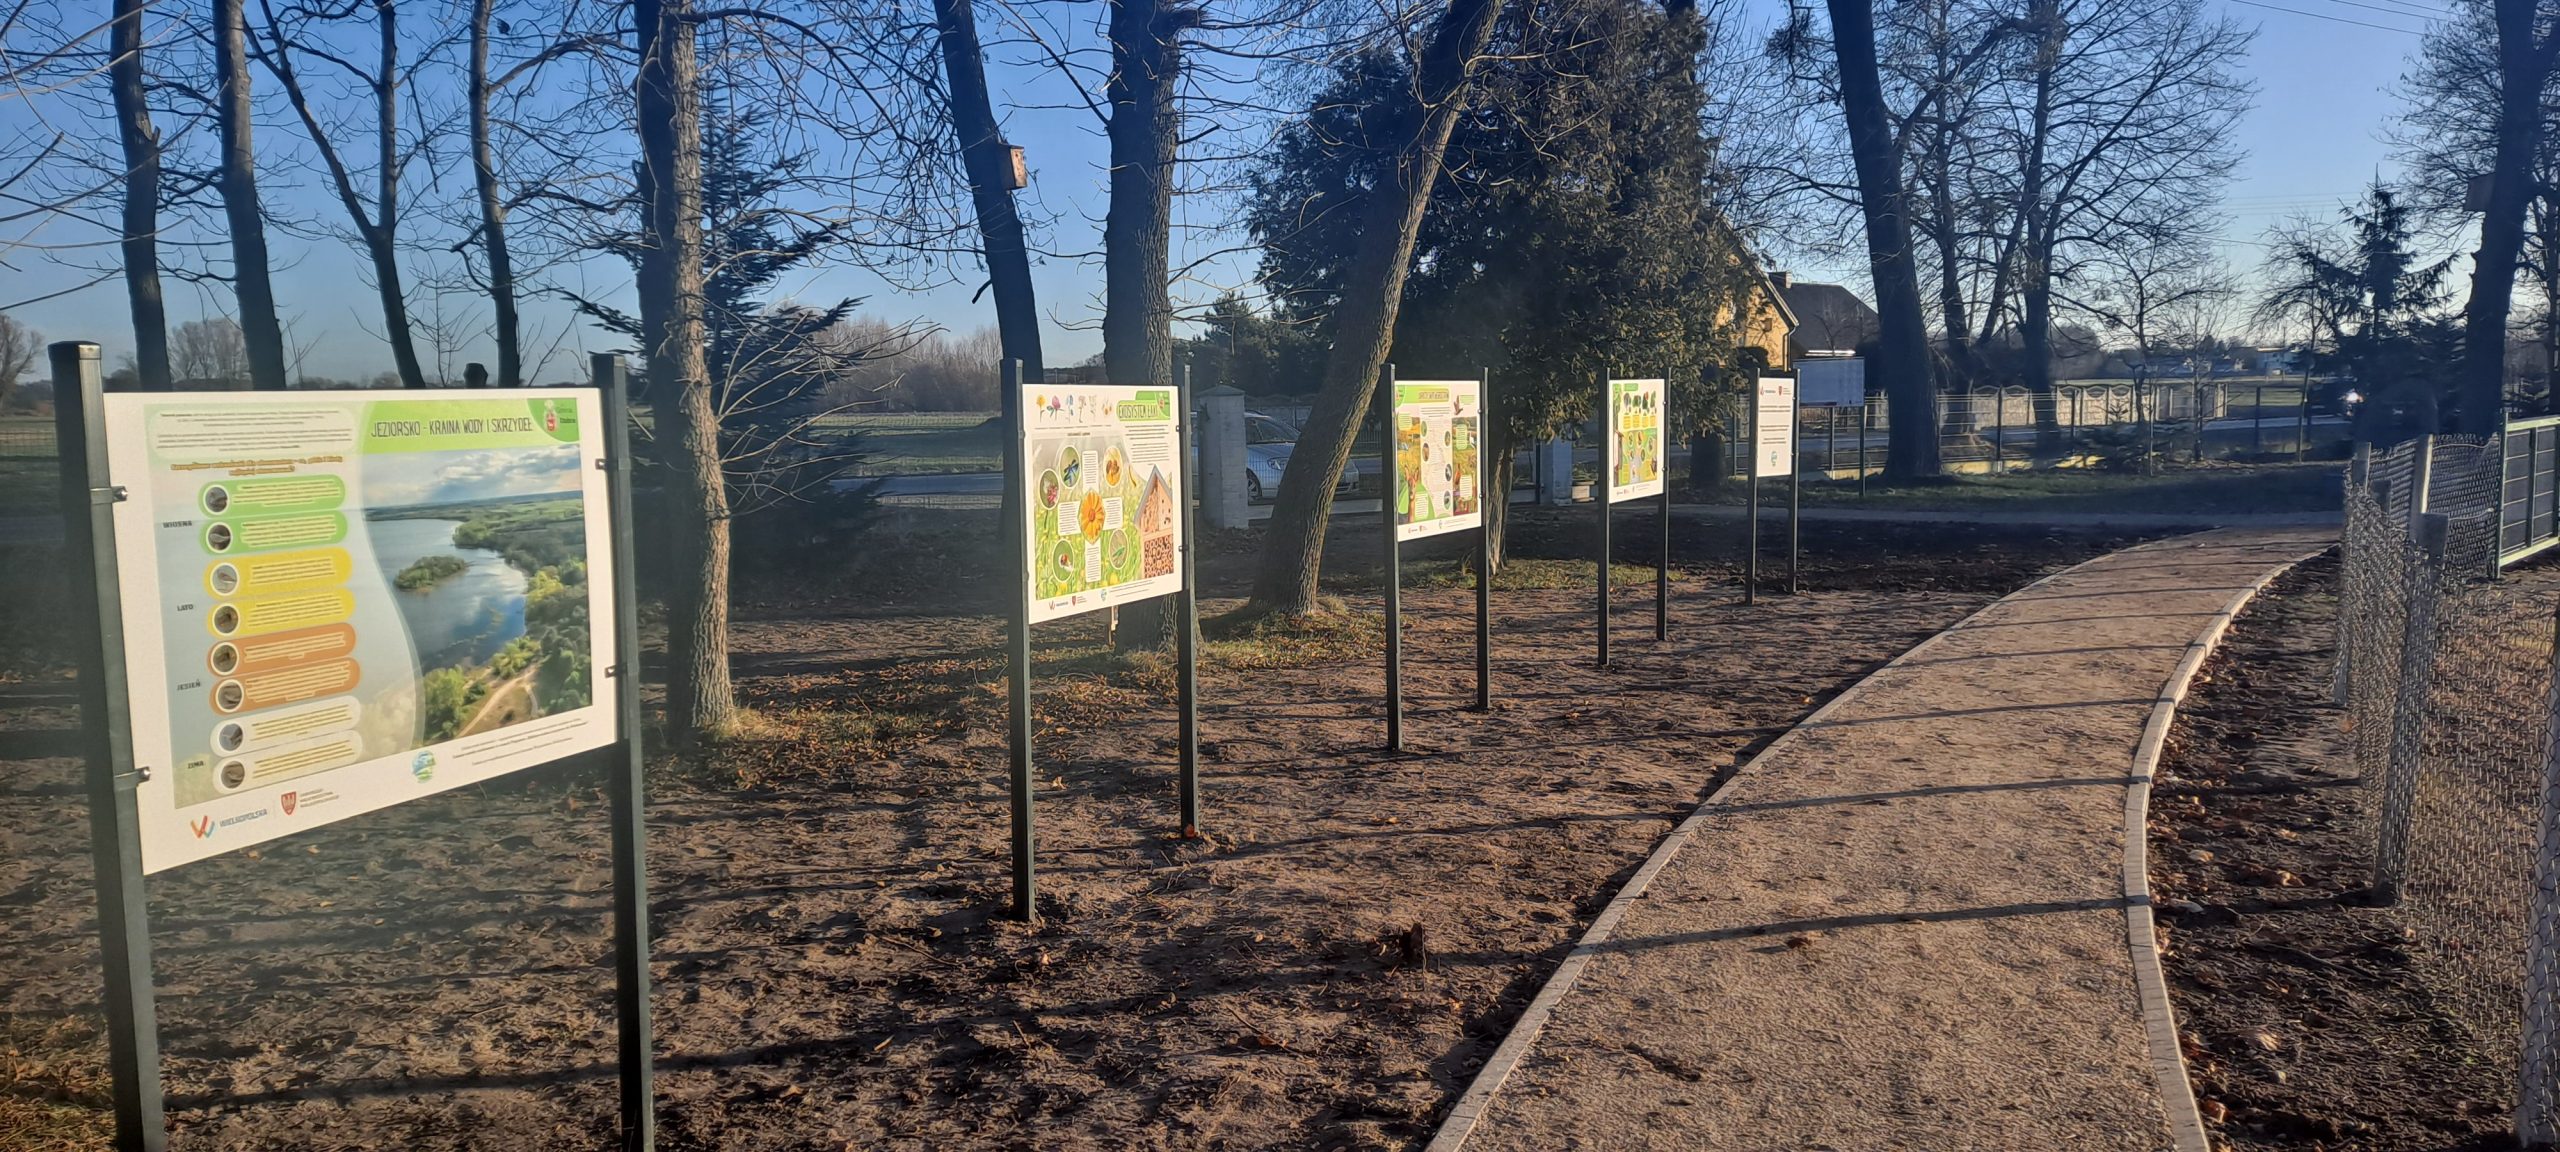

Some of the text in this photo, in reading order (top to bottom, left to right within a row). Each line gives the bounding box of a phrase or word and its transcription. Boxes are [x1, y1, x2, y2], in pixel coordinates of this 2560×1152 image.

[371, 421, 421, 437] JEZIORSKO
[429, 419, 460, 435] KRAINA
[462, 418, 483, 434] WODY
[486, 418, 490, 433] I
[491, 417, 534, 432] SKRZYDEŁ
